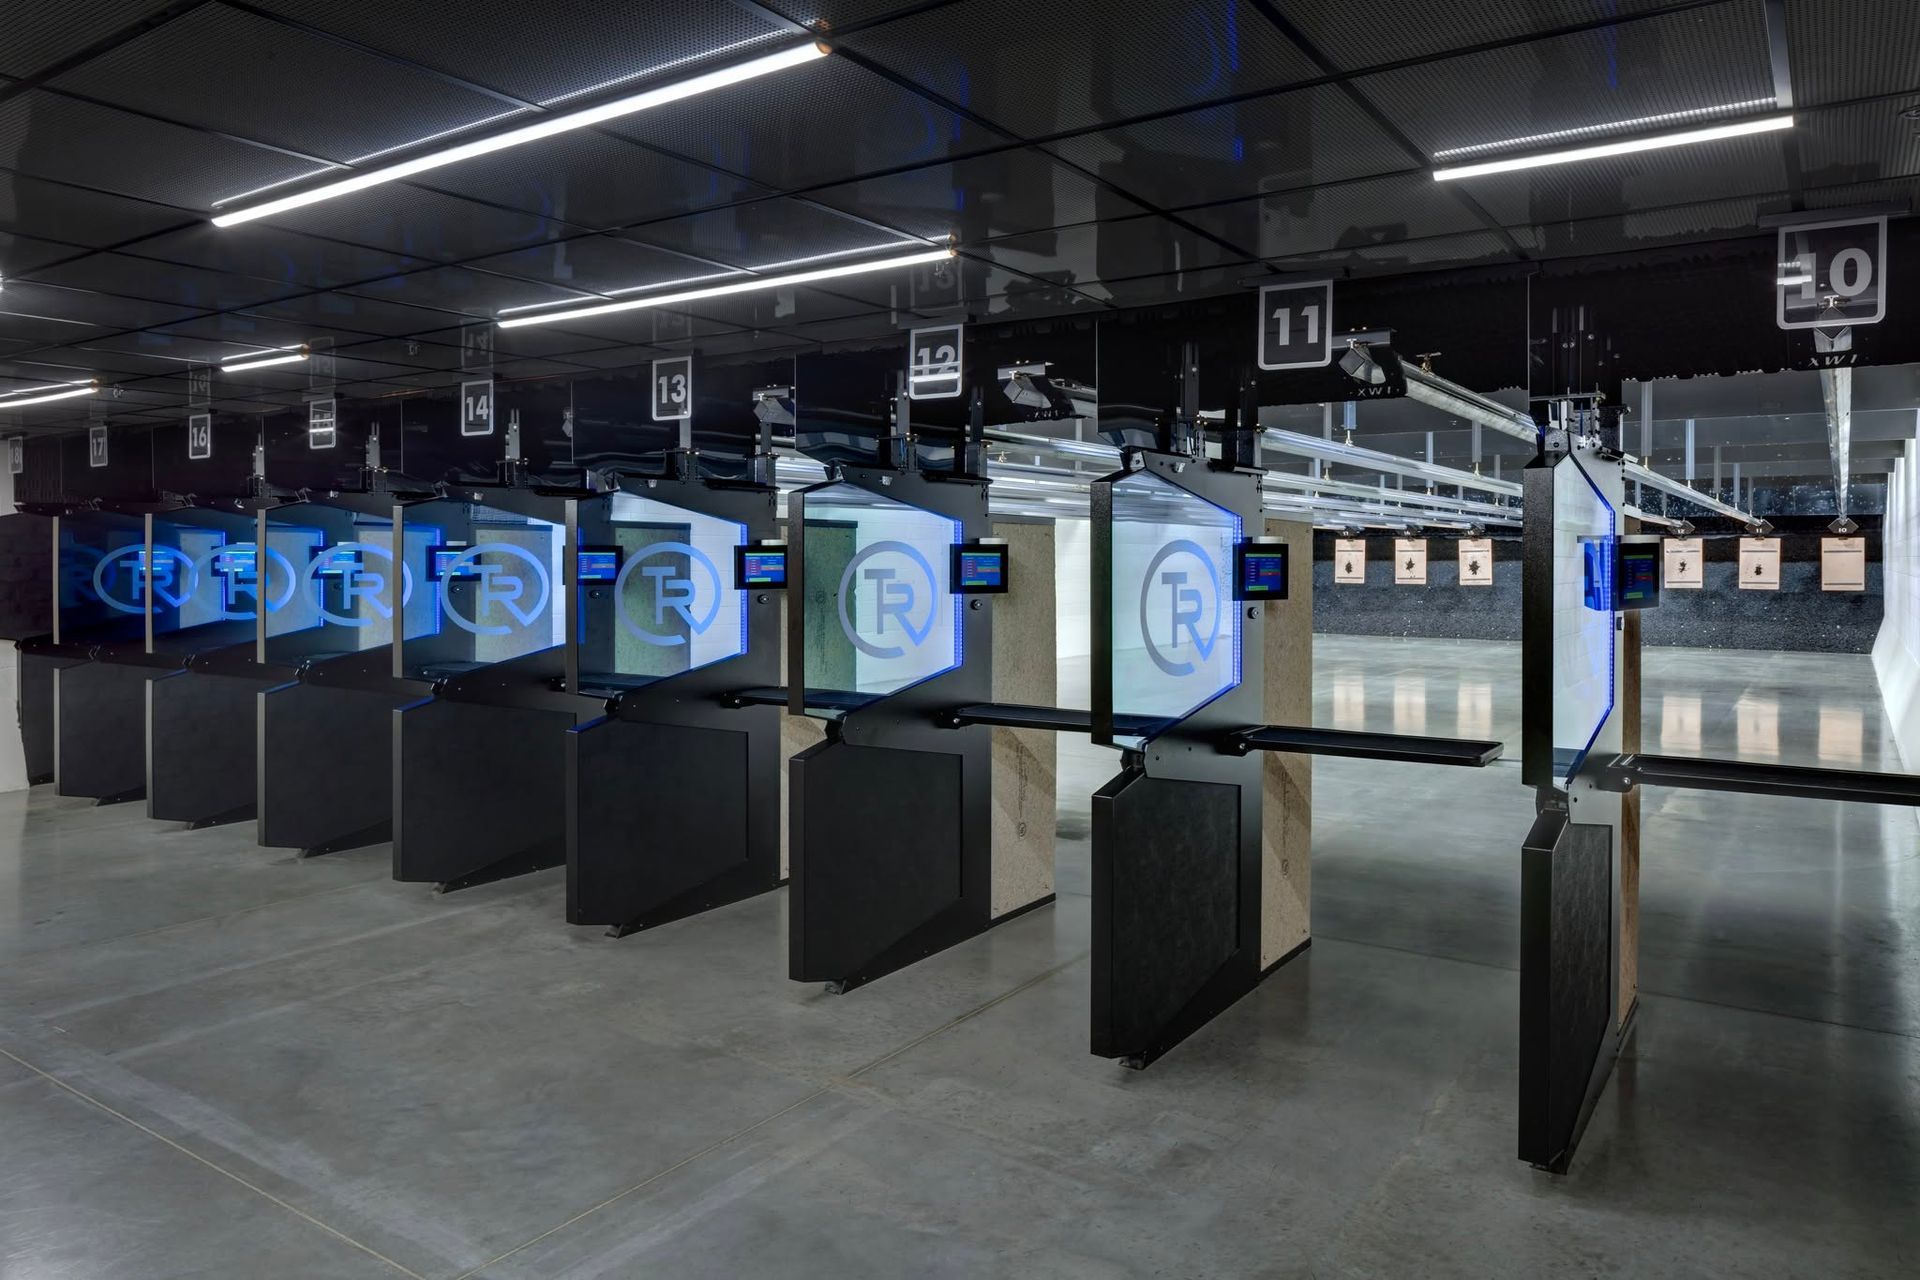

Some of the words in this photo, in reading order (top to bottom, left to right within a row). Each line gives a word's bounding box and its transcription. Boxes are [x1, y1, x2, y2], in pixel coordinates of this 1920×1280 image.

[1793, 247, 1873, 300] 10
[1272, 305, 1319, 346] 11
[917, 344, 956, 377] 12
[658, 374, 687, 404] 13
[466, 395, 489, 421] 14
[93, 437, 105, 457] 17
[192, 426, 207, 448] 16
